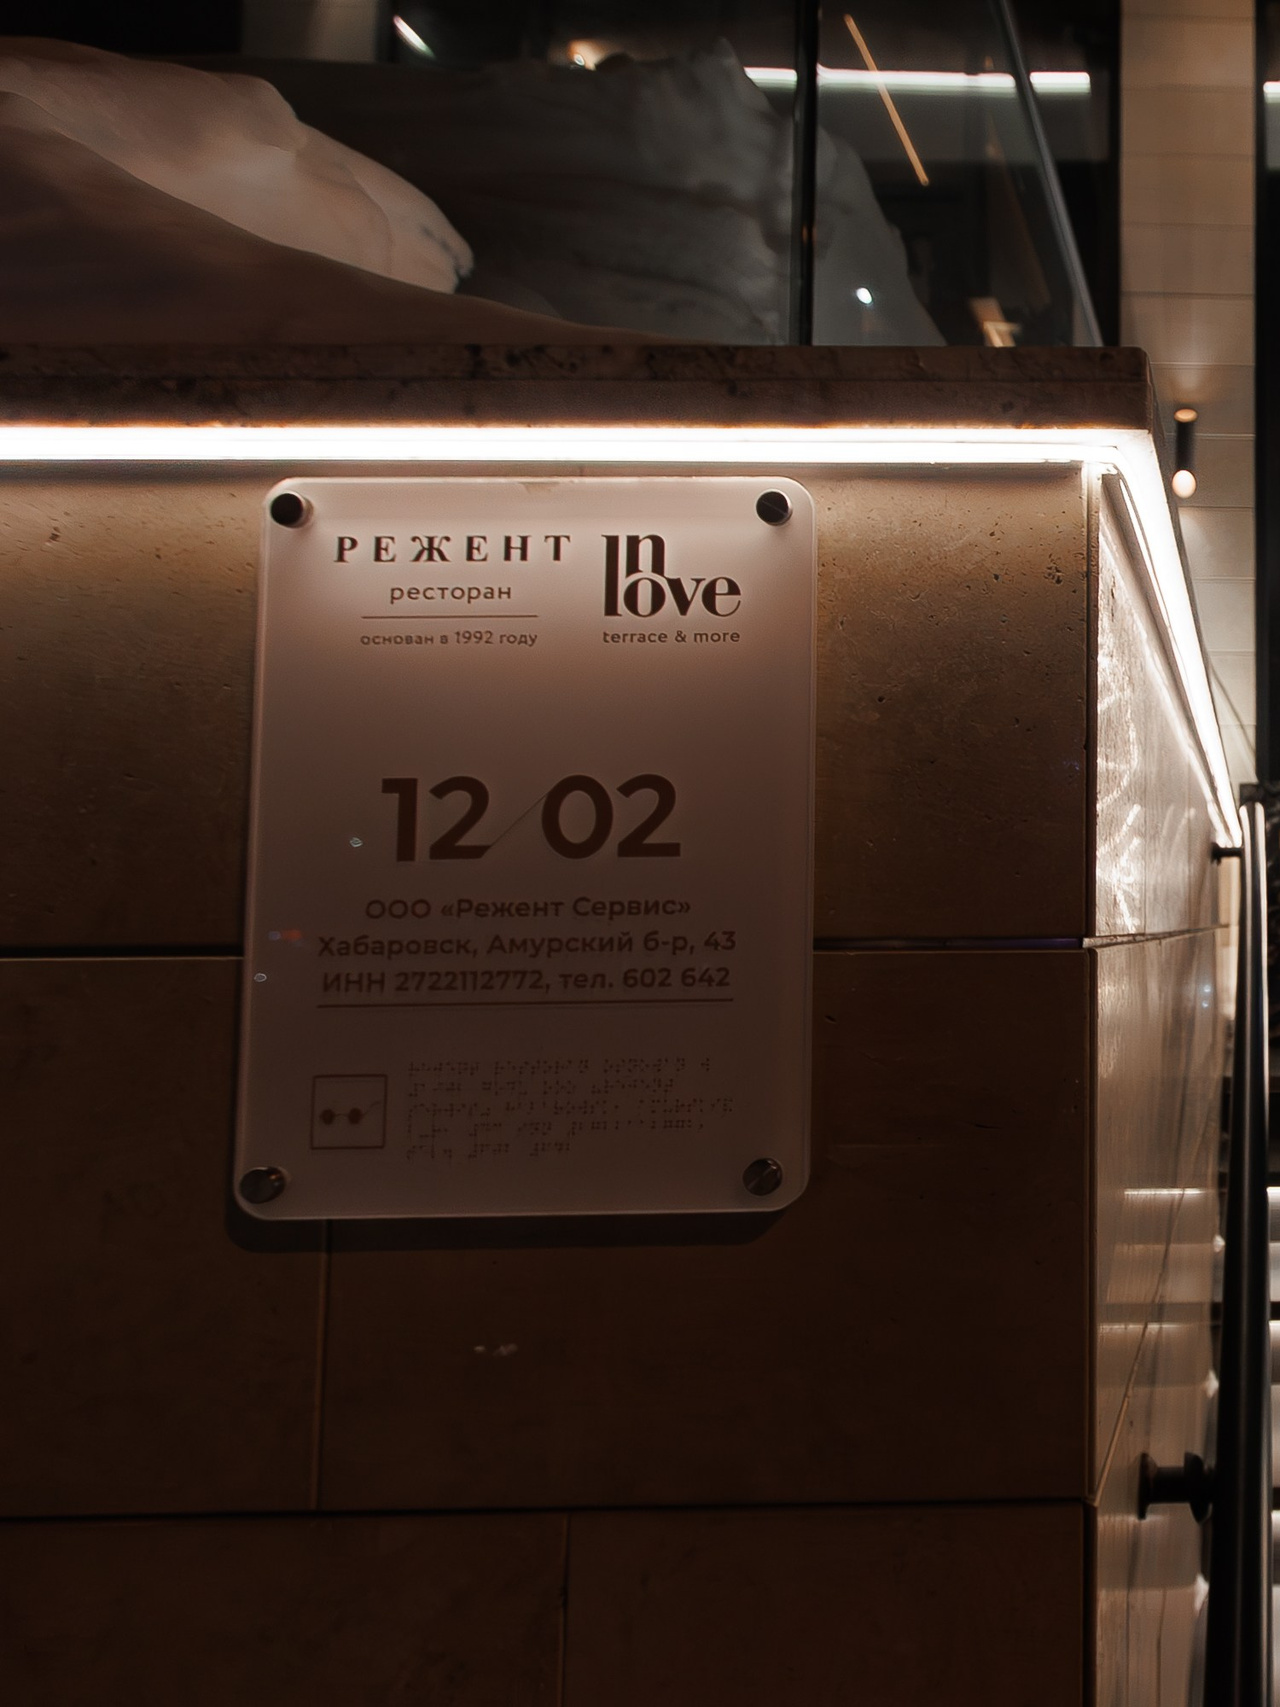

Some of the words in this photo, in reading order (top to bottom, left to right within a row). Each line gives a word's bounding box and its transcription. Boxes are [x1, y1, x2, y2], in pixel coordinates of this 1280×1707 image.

[333, 534, 571, 563] РЕЖЕНТ
[389, 585, 512, 605] ресторан
[359, 634, 435, 646] основан
[439, 634, 449, 646] в
[454, 630, 494, 646] 1992
[498, 632, 539, 648] году
[602, 630, 668, 644] terrace
[673, 630, 687, 644] &
[693, 631, 741, 644] more
[365, 897, 432, 920] ООО
[440, 897, 565, 919] «Режент
[572, 895, 691, 920] Сервис»
[317, 933, 479, 960] Хабаровск,
[486, 930, 634, 958] Амурский
[643, 931, 695, 955] б-р,
[702, 930, 737, 951] 43
[322, 971, 386, 994] ИНН
[394, 969, 550, 993] 2722112772,
[558, 970, 614, 990] тел.
[622, 967, 672, 988] 602
[680, 966, 731, 987] 642
